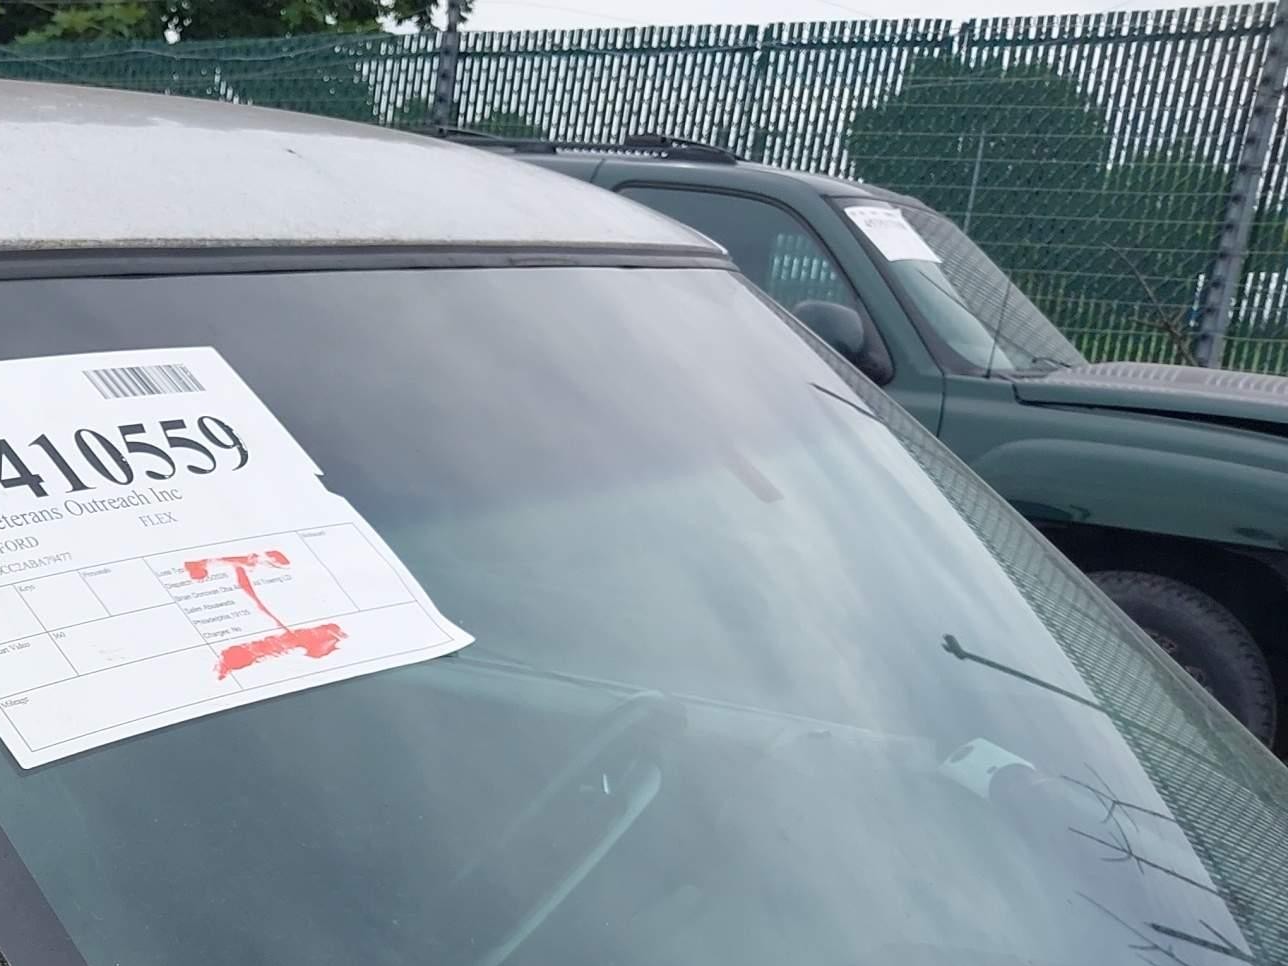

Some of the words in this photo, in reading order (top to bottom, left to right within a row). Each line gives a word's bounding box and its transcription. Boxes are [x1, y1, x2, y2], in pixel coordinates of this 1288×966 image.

[64, 489, 152, 517] Outreach
[152, 486, 183, 503] Inc
[138, 511, 178, 528] FLEX
